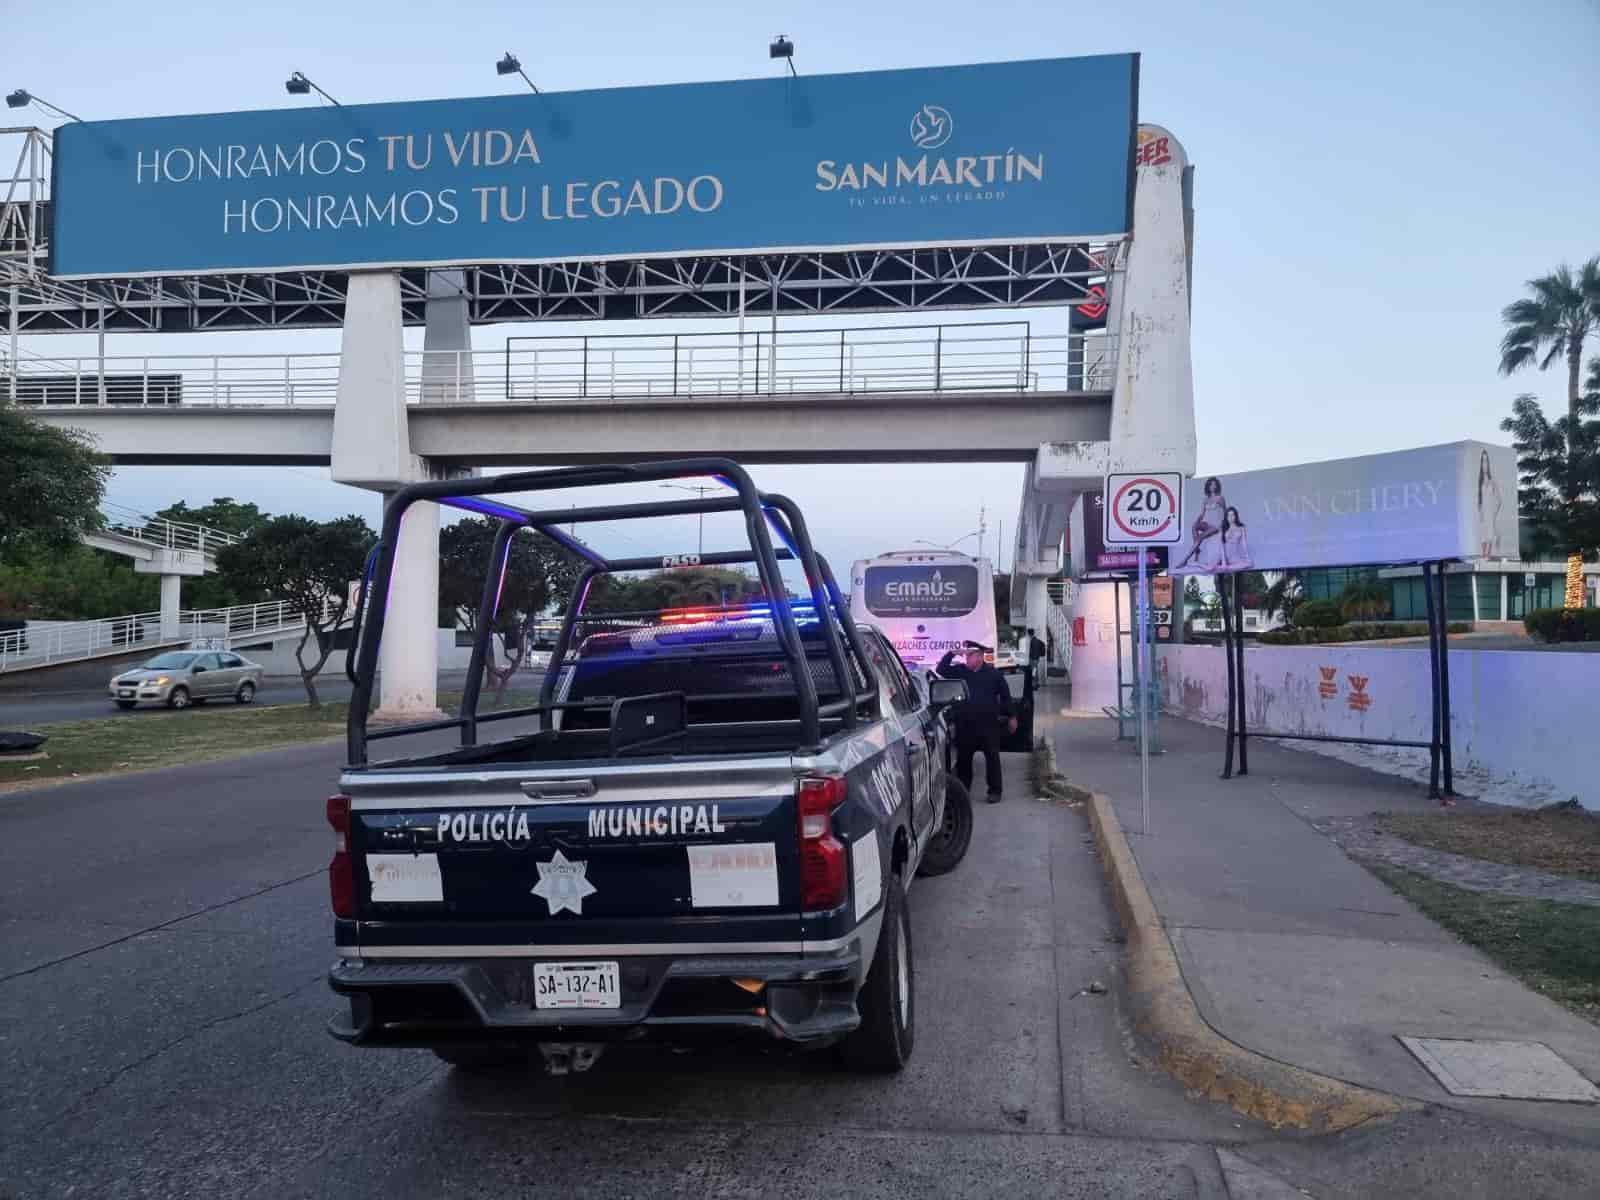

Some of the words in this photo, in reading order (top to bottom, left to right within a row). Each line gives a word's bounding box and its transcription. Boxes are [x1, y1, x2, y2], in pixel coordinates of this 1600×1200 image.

[137, 138, 366, 184] HONRAMOS
[378, 134, 432, 171] TU
[443, 128, 541, 168] VIDA
[815, 160, 888, 191] SAN
[896, 147, 1043, 187] MARTÍN
[224, 189, 458, 232] HONRAMOS
[472, 186, 526, 223] TU
[542, 175, 723, 220] LEGADO
[1127, 489, 1162, 512] 20
[1263, 494, 1321, 522] ANN
[1330, 479, 1446, 515] CHERY
[1129, 515, 1160, 527] Km/h
[929, 640, 961, 650] CENTRO
[437, 806, 531, 842] POLICÍA
[588, 804, 725, 838] MUNICIPAL
